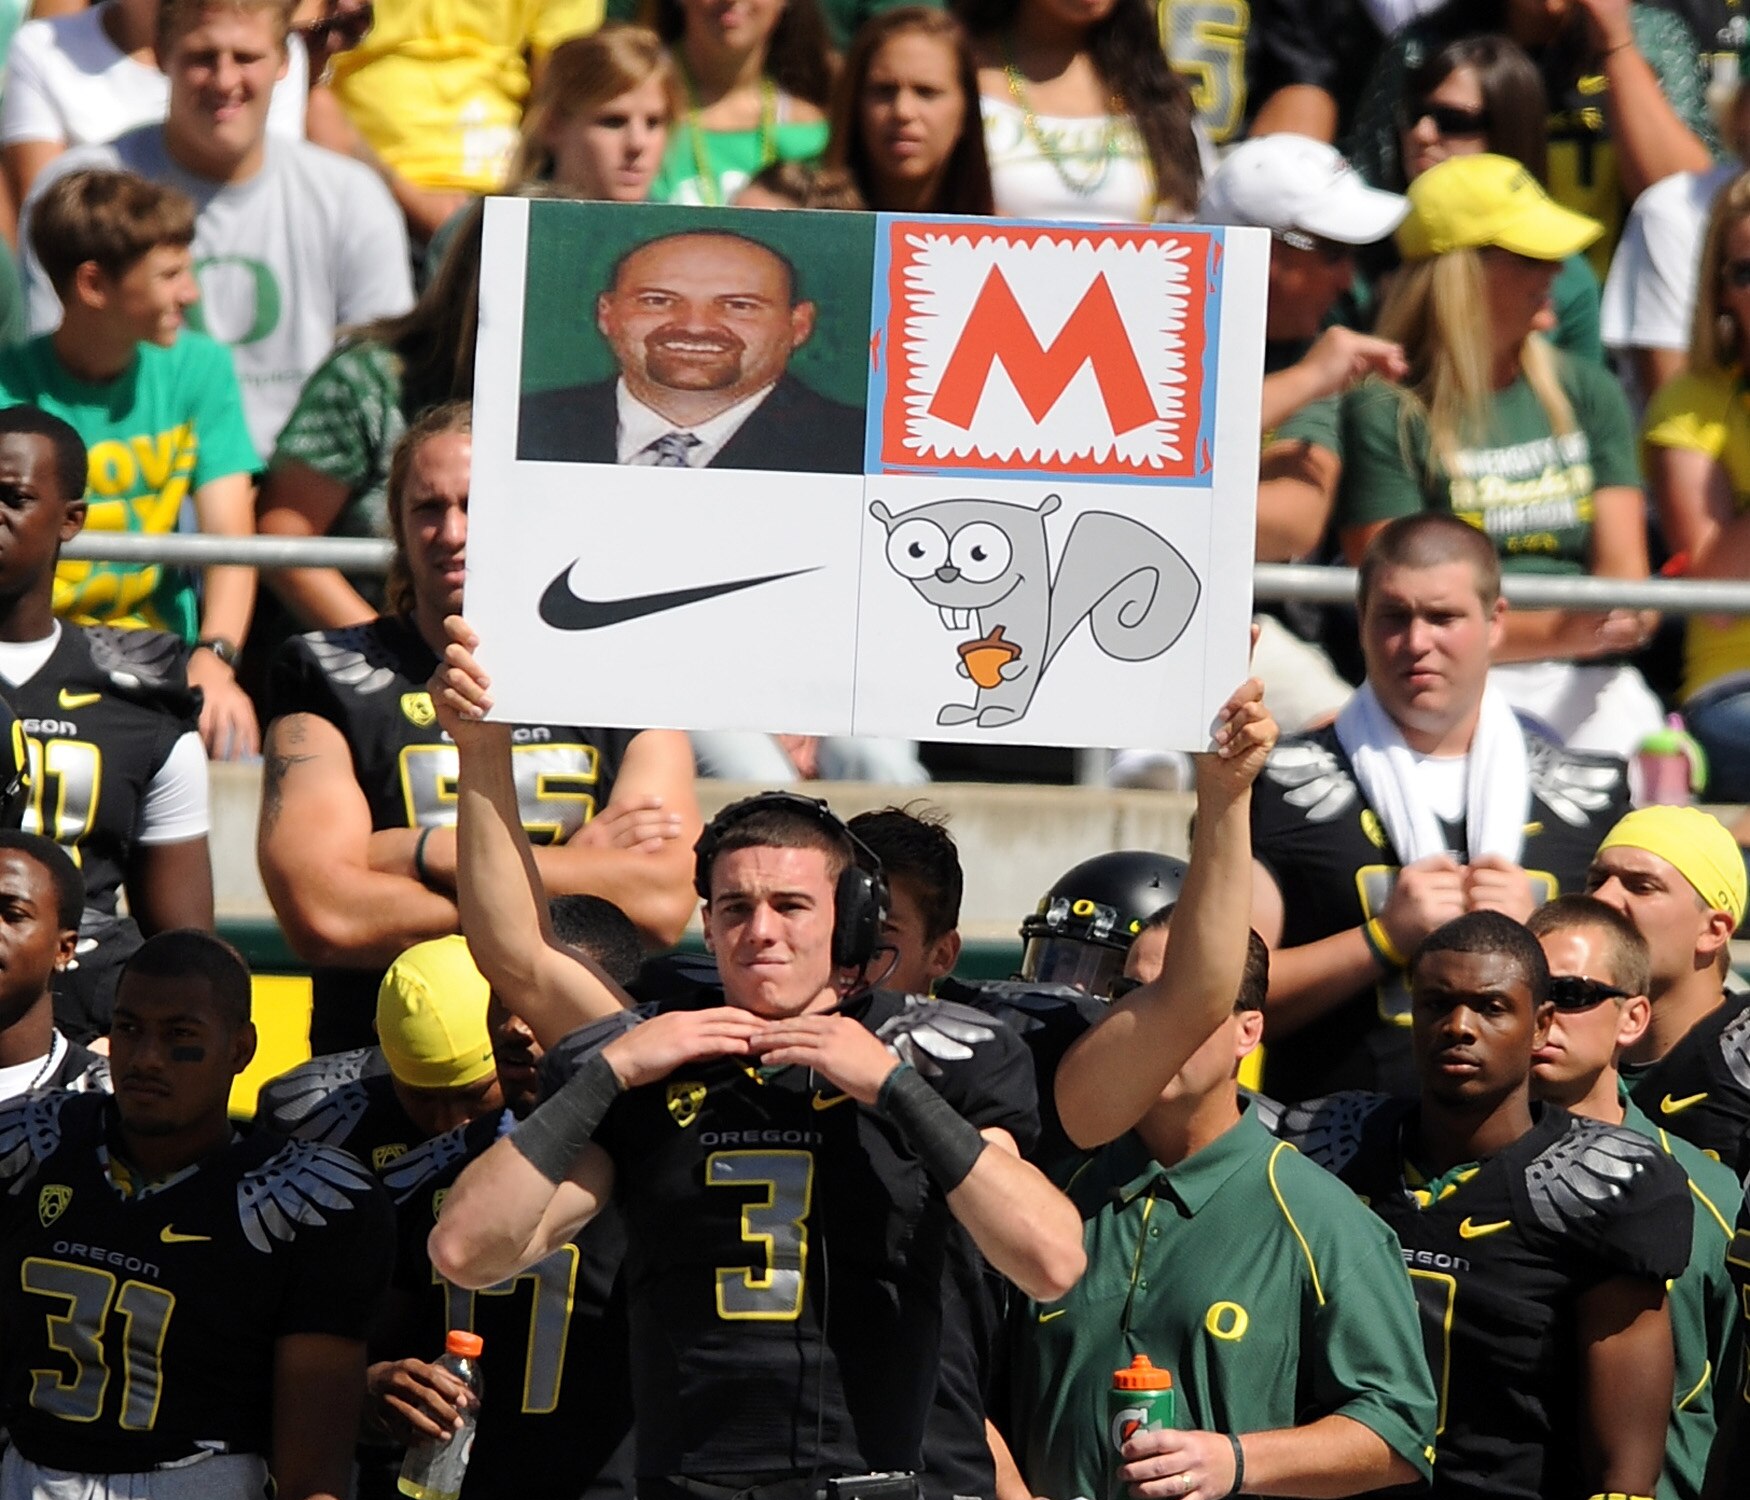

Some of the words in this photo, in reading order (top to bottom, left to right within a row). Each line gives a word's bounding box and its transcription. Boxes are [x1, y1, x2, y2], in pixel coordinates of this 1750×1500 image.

[927, 261, 1160, 438] M
[700, 1129, 824, 1146] OREGON
[53, 1240, 161, 1279] OREGON
[705, 1149, 814, 1321] 3
[1401, 1248, 1471, 1272] EGON
[21, 1256, 176, 1431] 31
